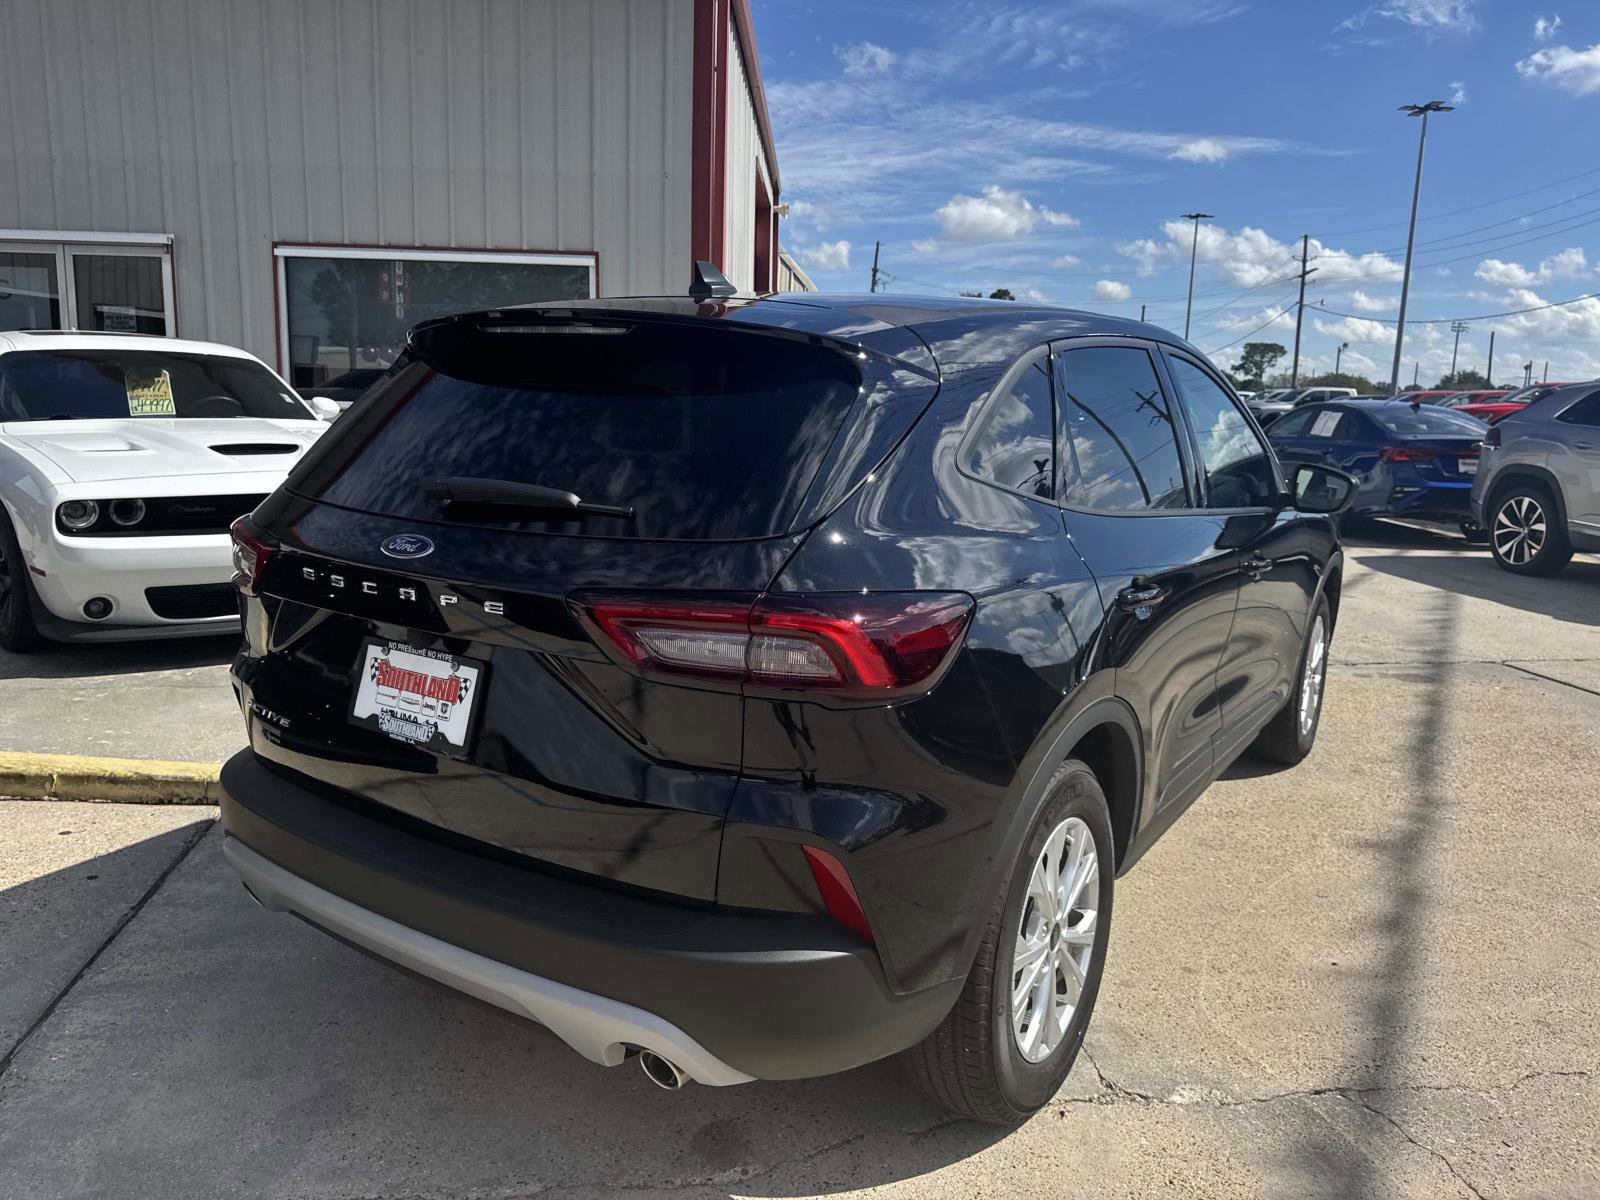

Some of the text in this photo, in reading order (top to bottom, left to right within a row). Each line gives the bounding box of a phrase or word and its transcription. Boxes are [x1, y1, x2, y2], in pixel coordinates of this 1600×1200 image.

[389, 537, 422, 552] Ford
[302, 567, 504, 615] ESCAPE
[388, 641, 453, 662] NO PRESSURE NO HYPE
[376, 659, 460, 705] SOUTHLAND
[422, 702, 436, 711] Jeep
[382, 714, 429, 742] SOUTHLAND
